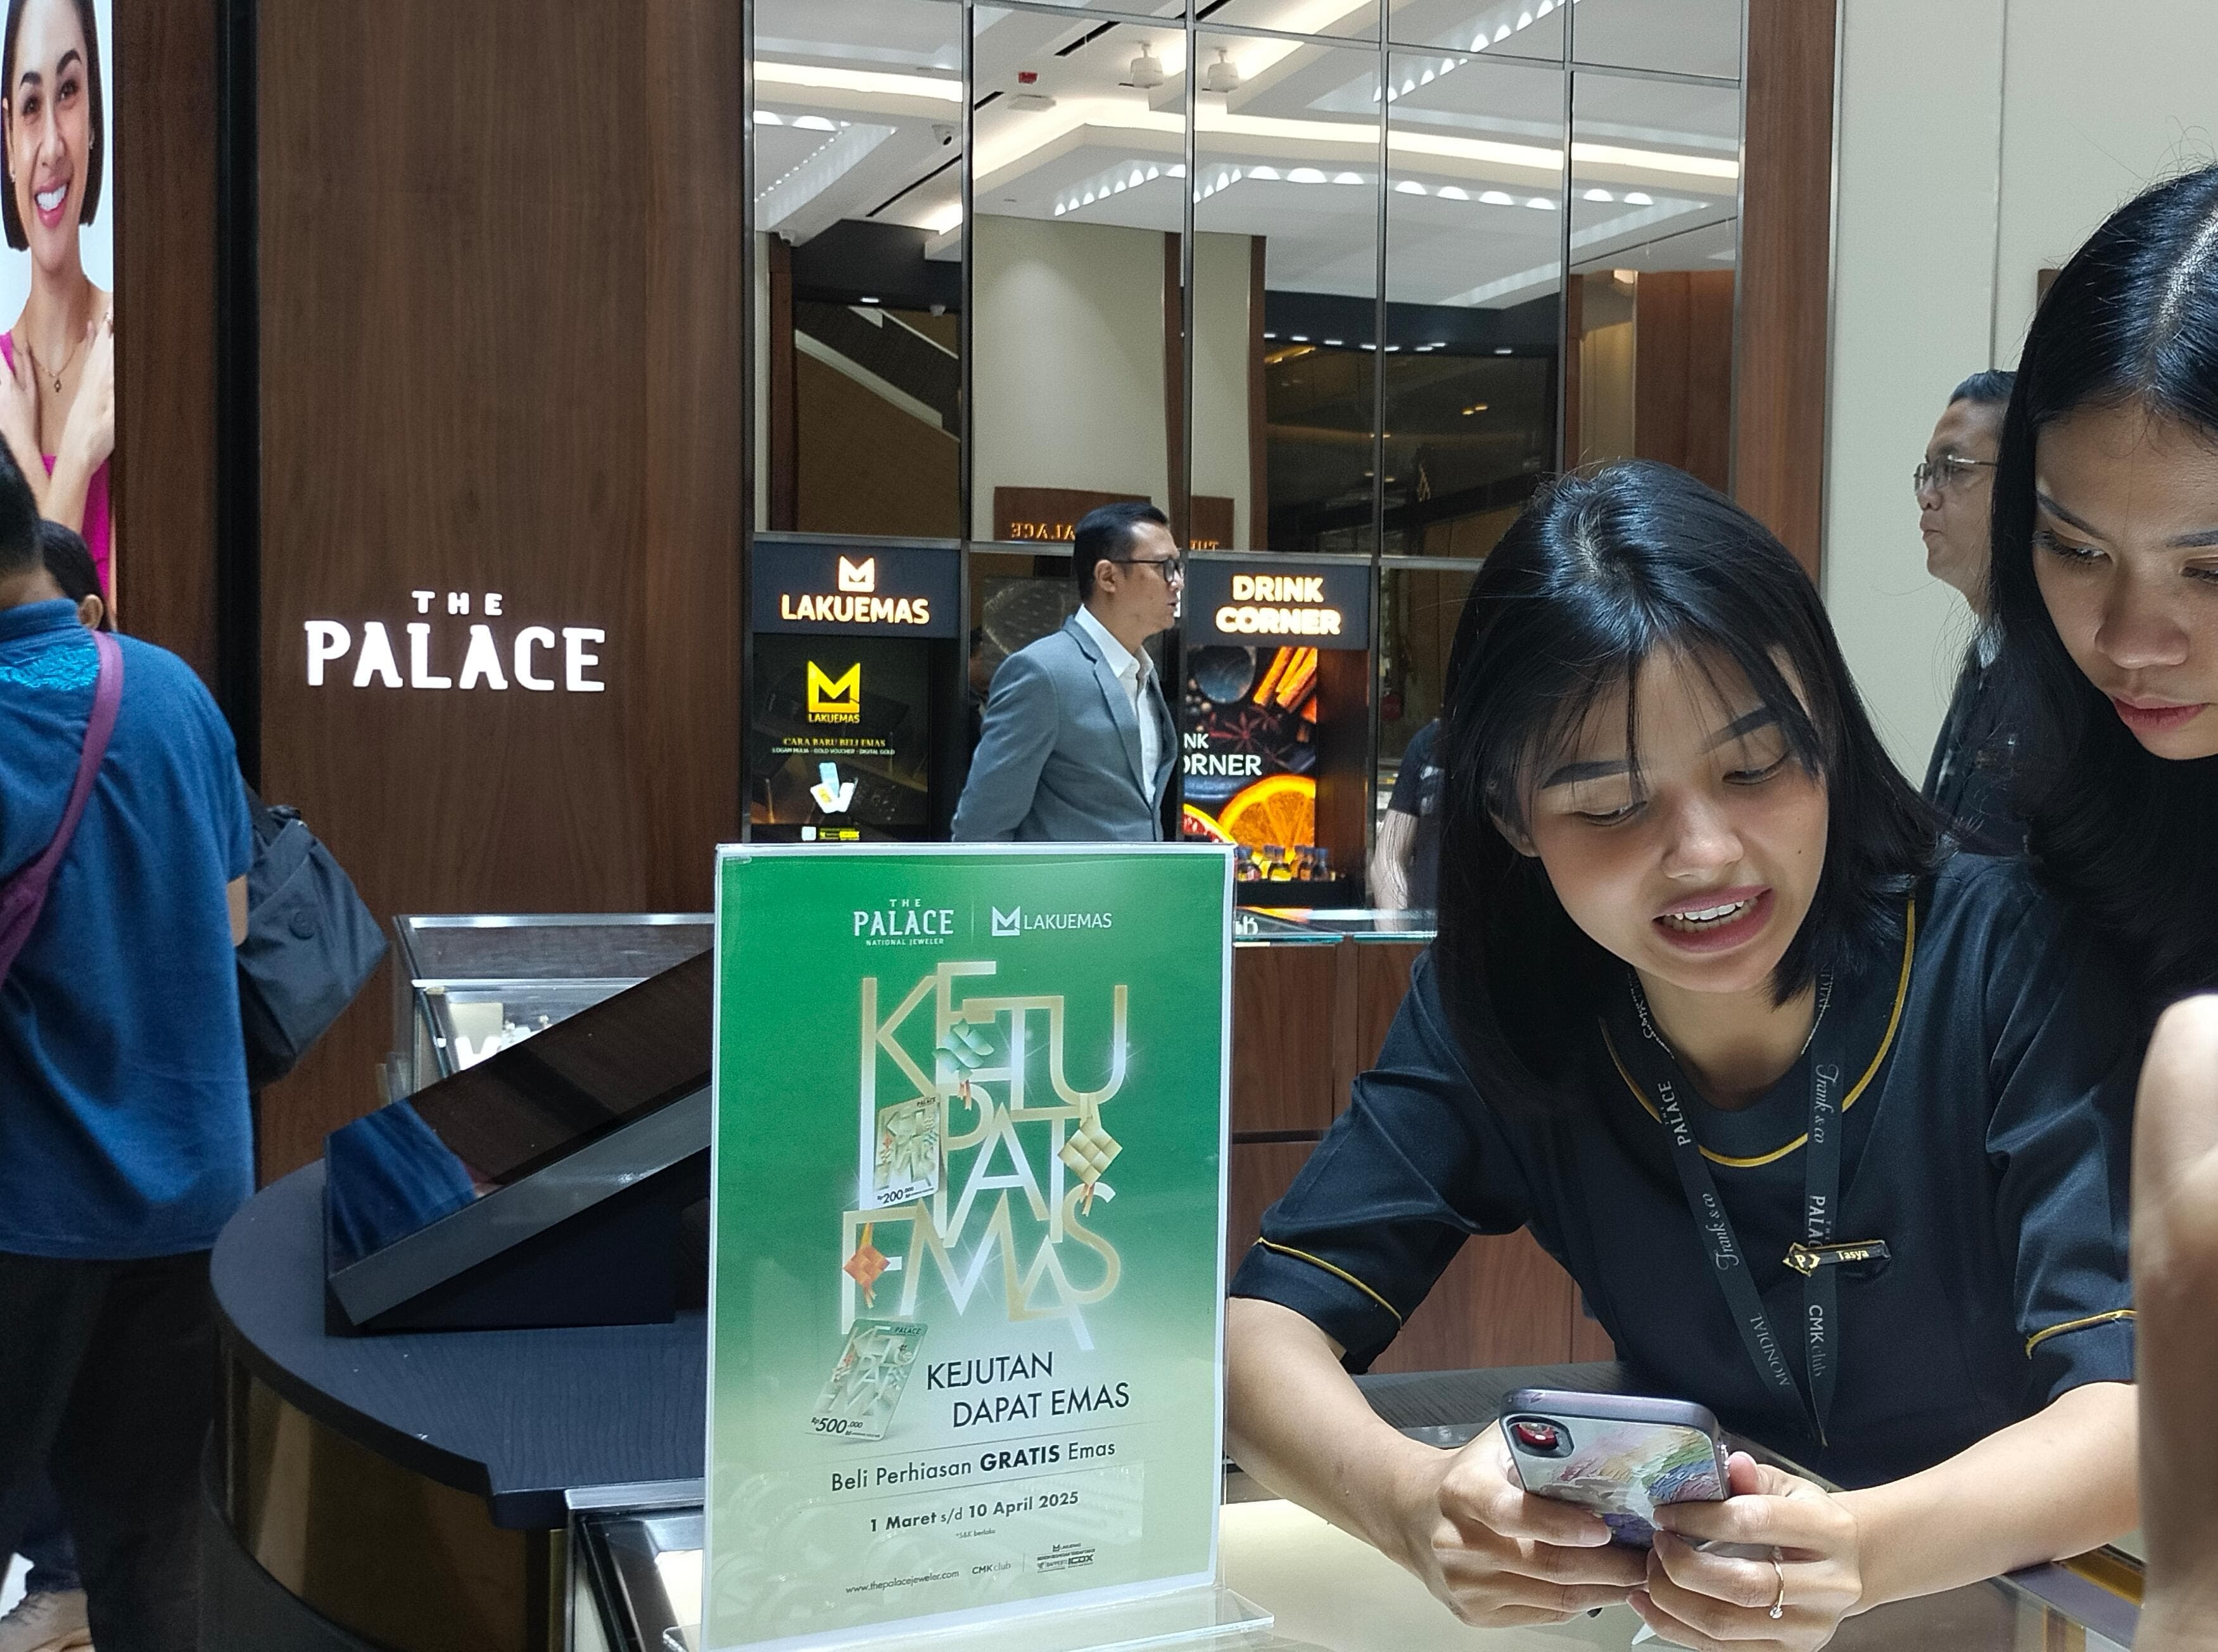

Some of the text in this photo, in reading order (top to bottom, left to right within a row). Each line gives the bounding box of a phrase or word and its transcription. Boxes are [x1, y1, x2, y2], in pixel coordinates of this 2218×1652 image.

[1233, 575, 1324, 602] DRINK
[412, 590, 502, 615] THE
[782, 594, 930, 624] LAKUEMAS
[1215, 606, 1341, 635] CORNER
[304, 620, 605, 692] PALACE
[808, 713, 860, 723] LAKUEMAS
[783, 737, 810, 746] CARA
[889, 899, 921, 908] THE
[853, 909, 954, 936] PALACE
[1024, 913, 1112, 930] LAKUEMAS
[909, 938, 944, 946] JEWELER
[1657, 1080, 1692, 1146] PALACE
[1837, 1248, 1869, 1261] Tasya
[1750, 1312, 1790, 1386] MONDIAL
[927, 1351, 1053, 1390] KEJUTAN
[953, 1382, 1129, 1428] DAPAT EMAS
[832, 1442, 1116, 1491] Beli Perhiasan GRATIS Emas
[871, 1491, 1079, 1532] 1 Maret s/d 10 April 2025
[846, 1570, 960, 1594] www.thepalacejeweler.com
